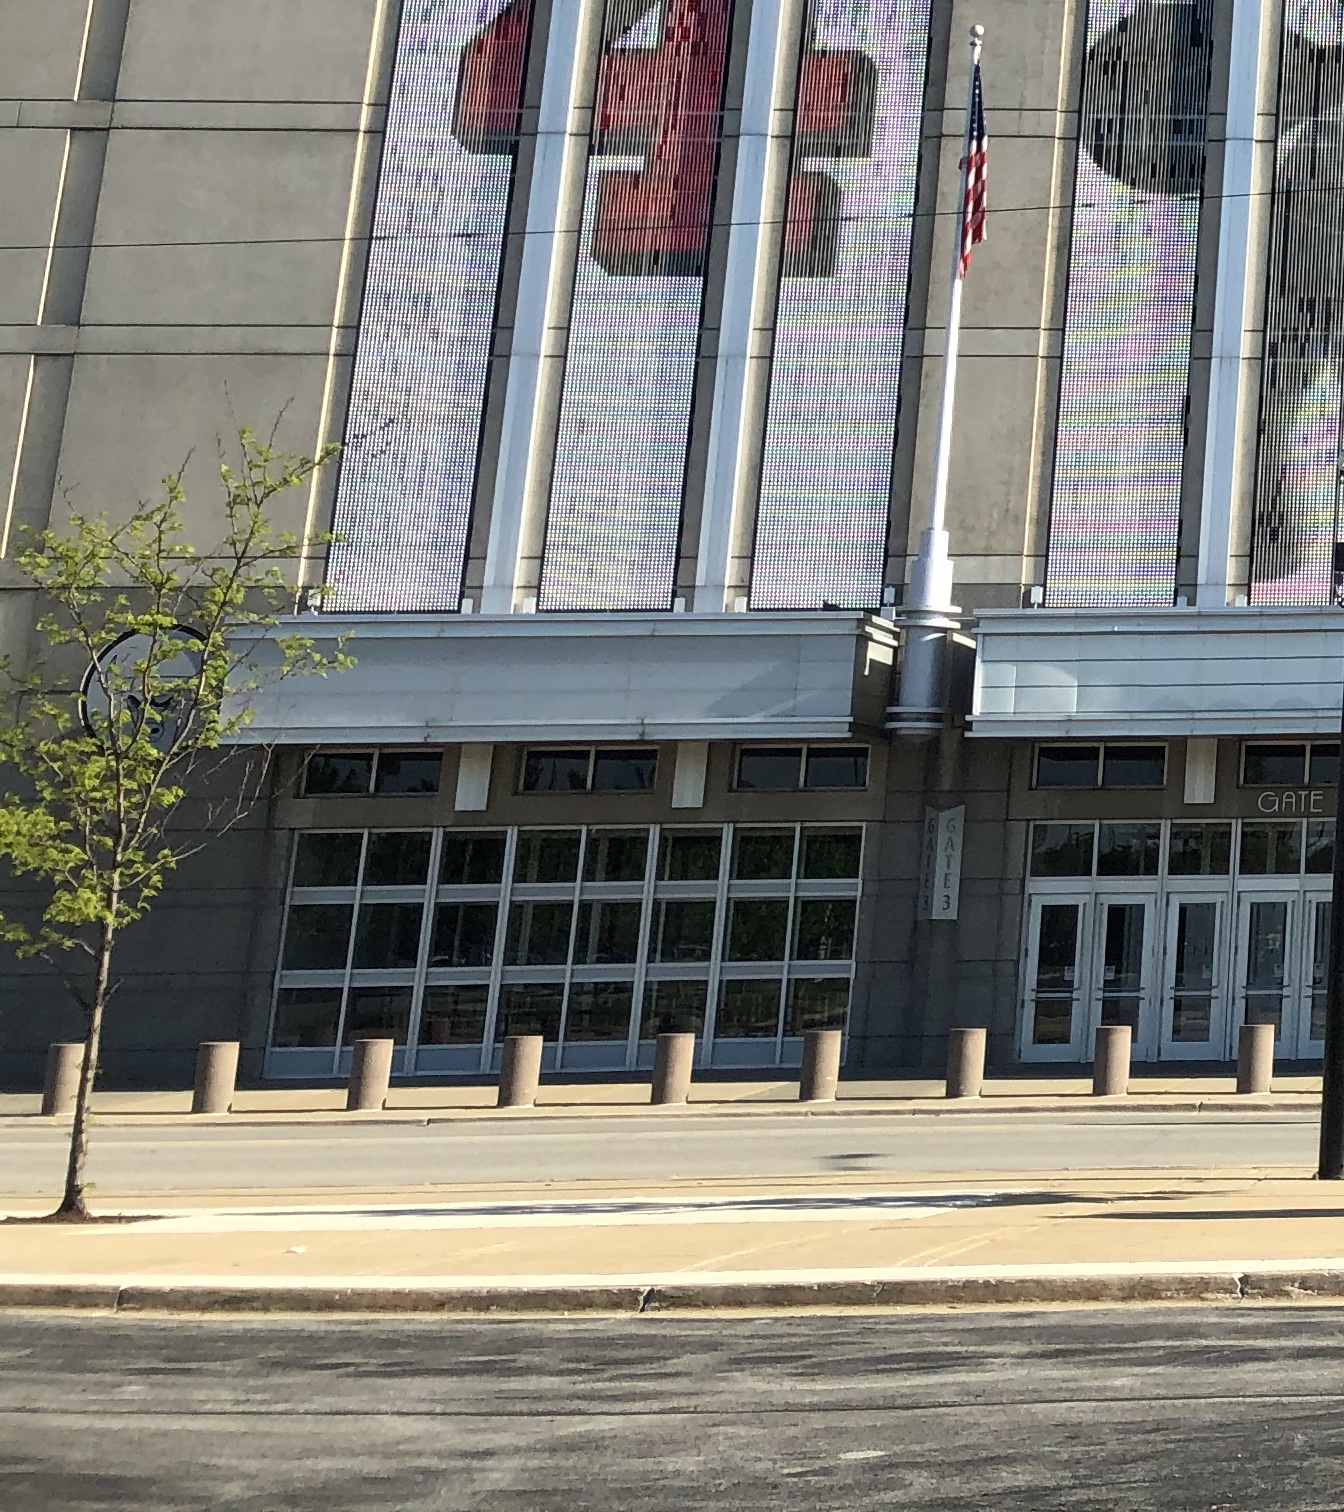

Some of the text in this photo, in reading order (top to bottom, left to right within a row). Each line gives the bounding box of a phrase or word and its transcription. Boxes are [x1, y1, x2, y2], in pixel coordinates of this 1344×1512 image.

[1257, 791, 1323, 813] GATE
[942, 817, 956, 911] GATE 3
